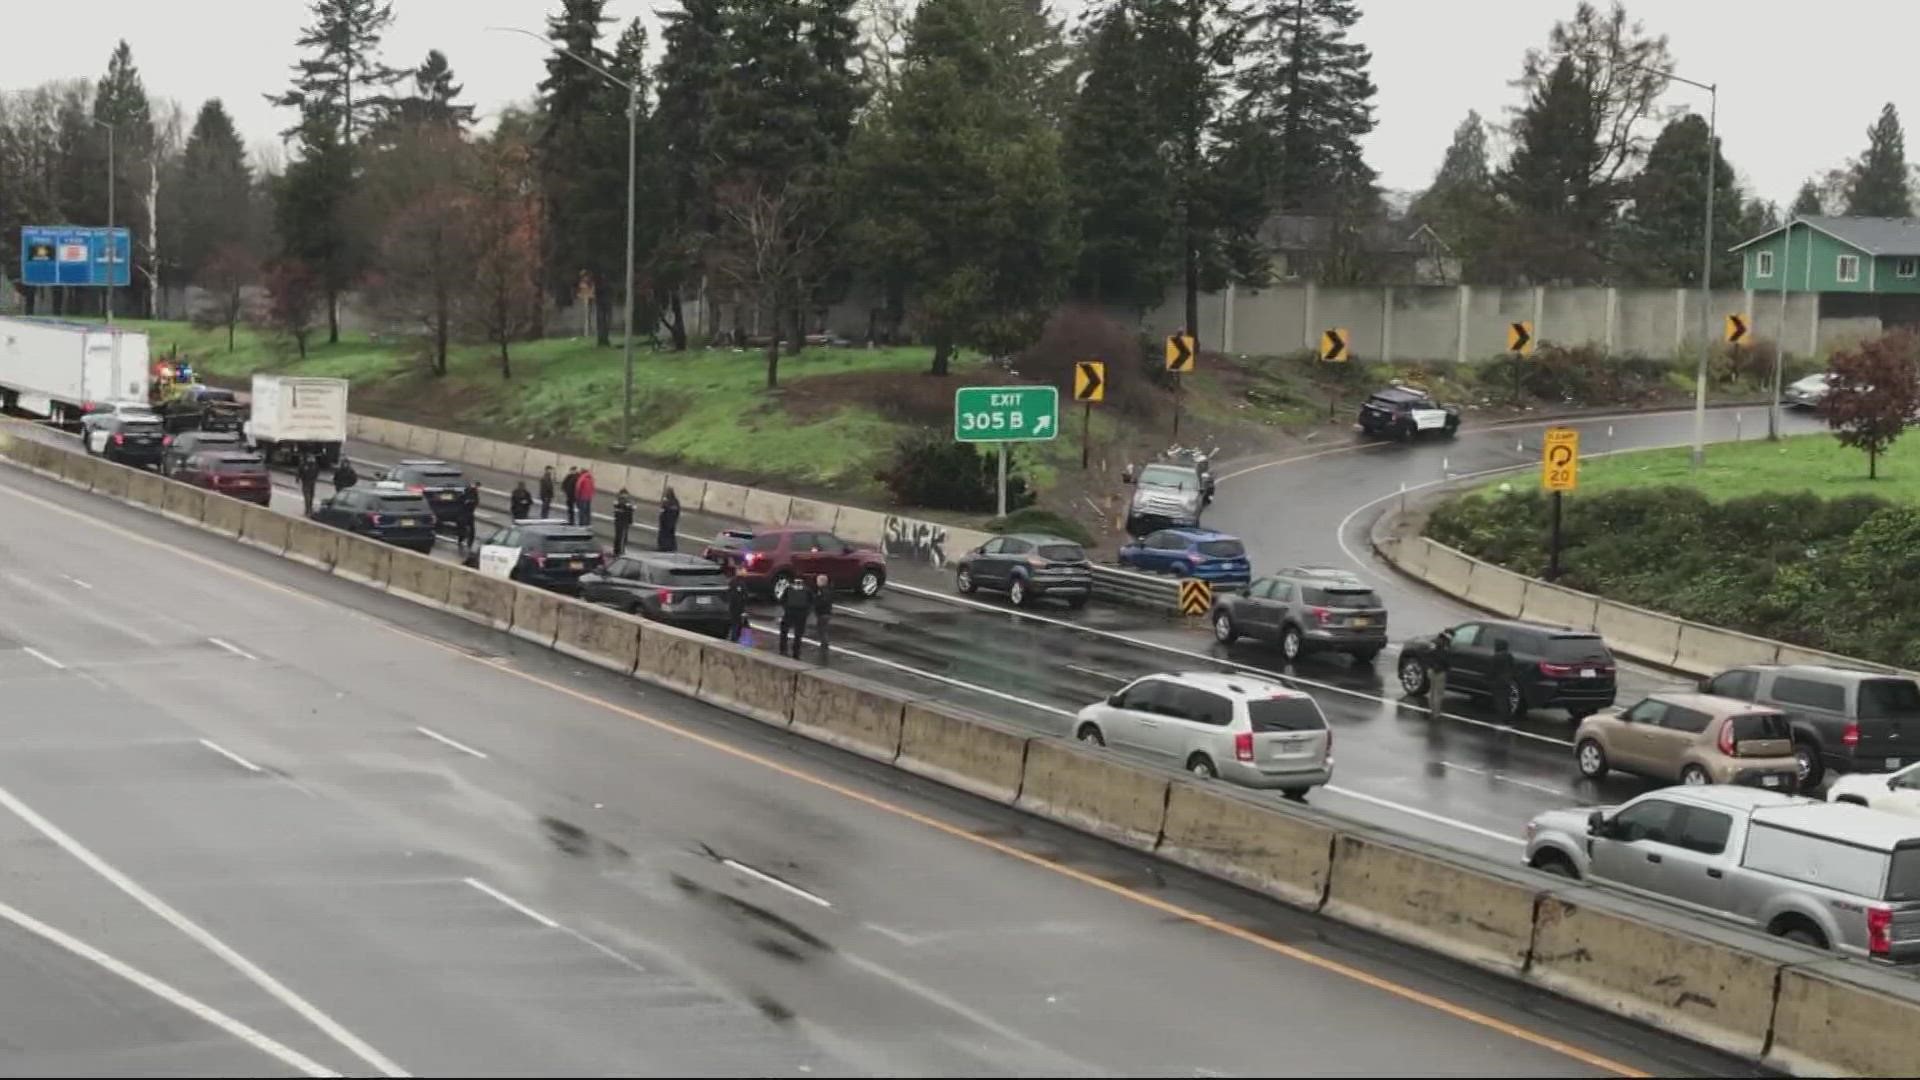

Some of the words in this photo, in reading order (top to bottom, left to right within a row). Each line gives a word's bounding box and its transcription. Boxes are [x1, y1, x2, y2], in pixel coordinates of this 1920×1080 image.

[990, 393, 1023, 406] EXIT
[961, 411, 1005, 430] 305
[1010, 411, 1024, 429] B
[1550, 469, 1570, 482] 20
